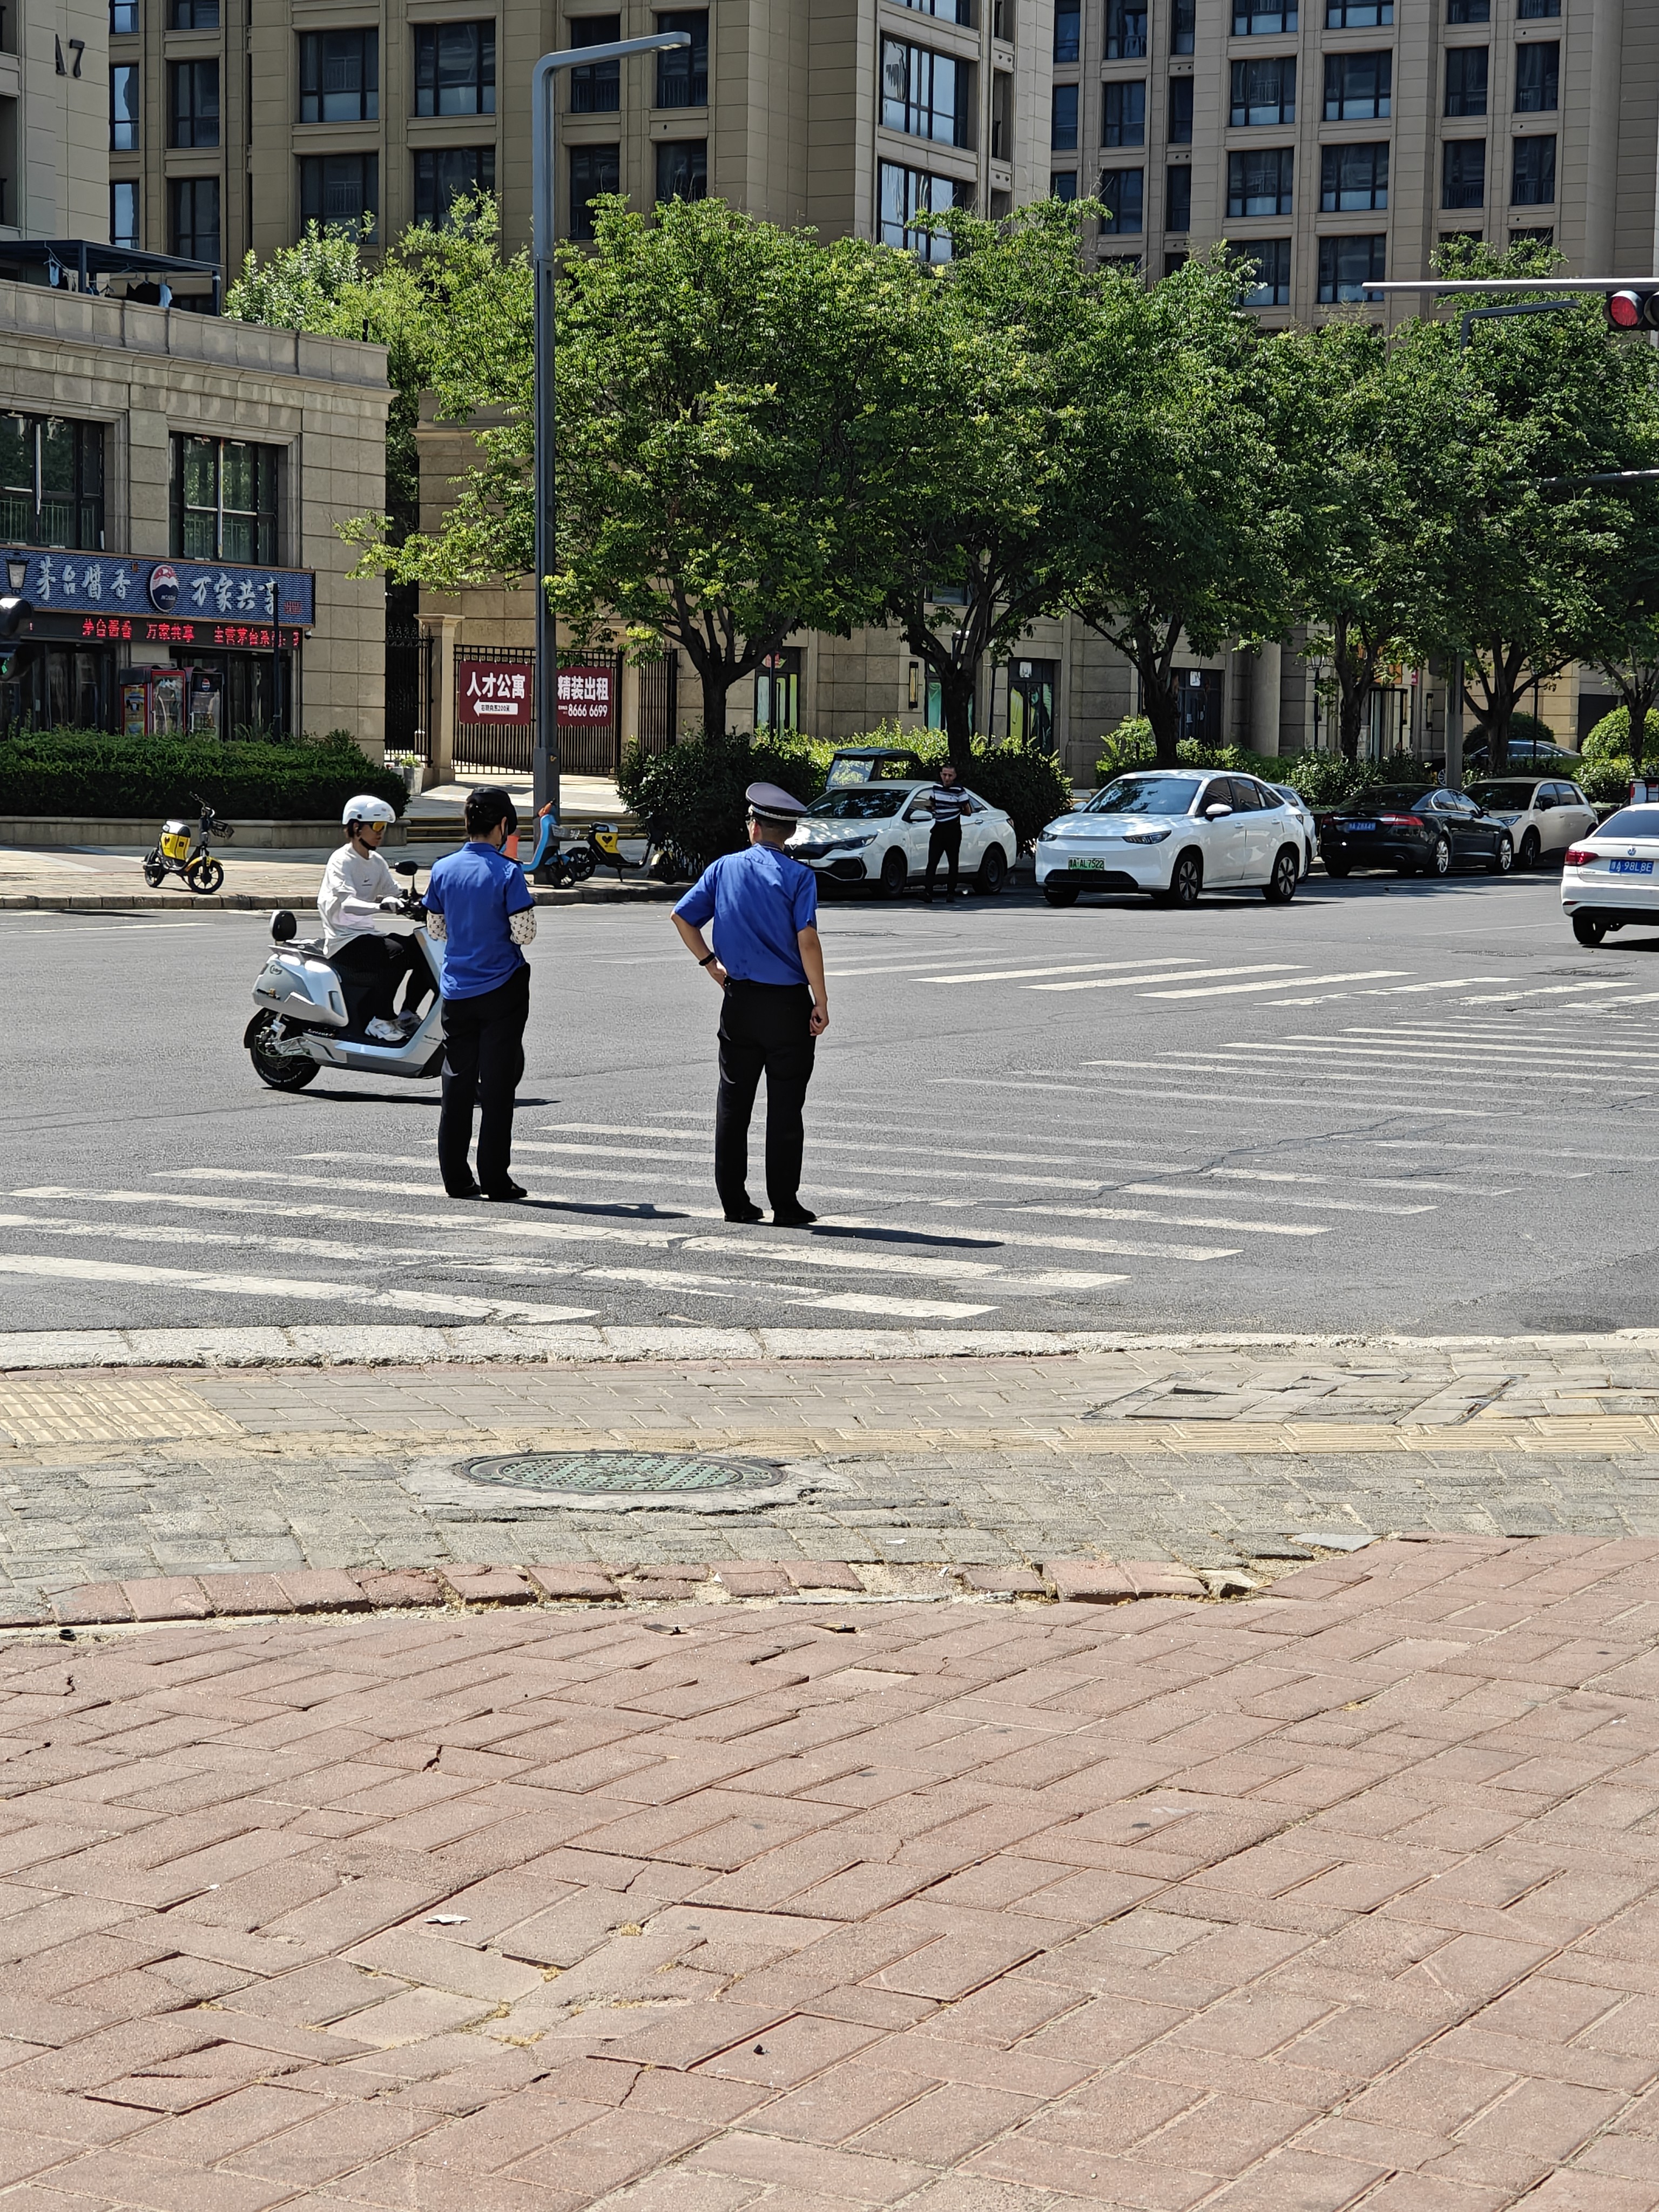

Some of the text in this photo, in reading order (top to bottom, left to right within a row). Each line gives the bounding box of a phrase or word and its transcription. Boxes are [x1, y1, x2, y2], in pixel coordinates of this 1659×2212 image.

[466, 671, 525, 699] 人才公寓
[557, 675, 609, 701] 精装出租
[568, 703, 587, 717] 8666
[589, 704, 608, 717] 6699
